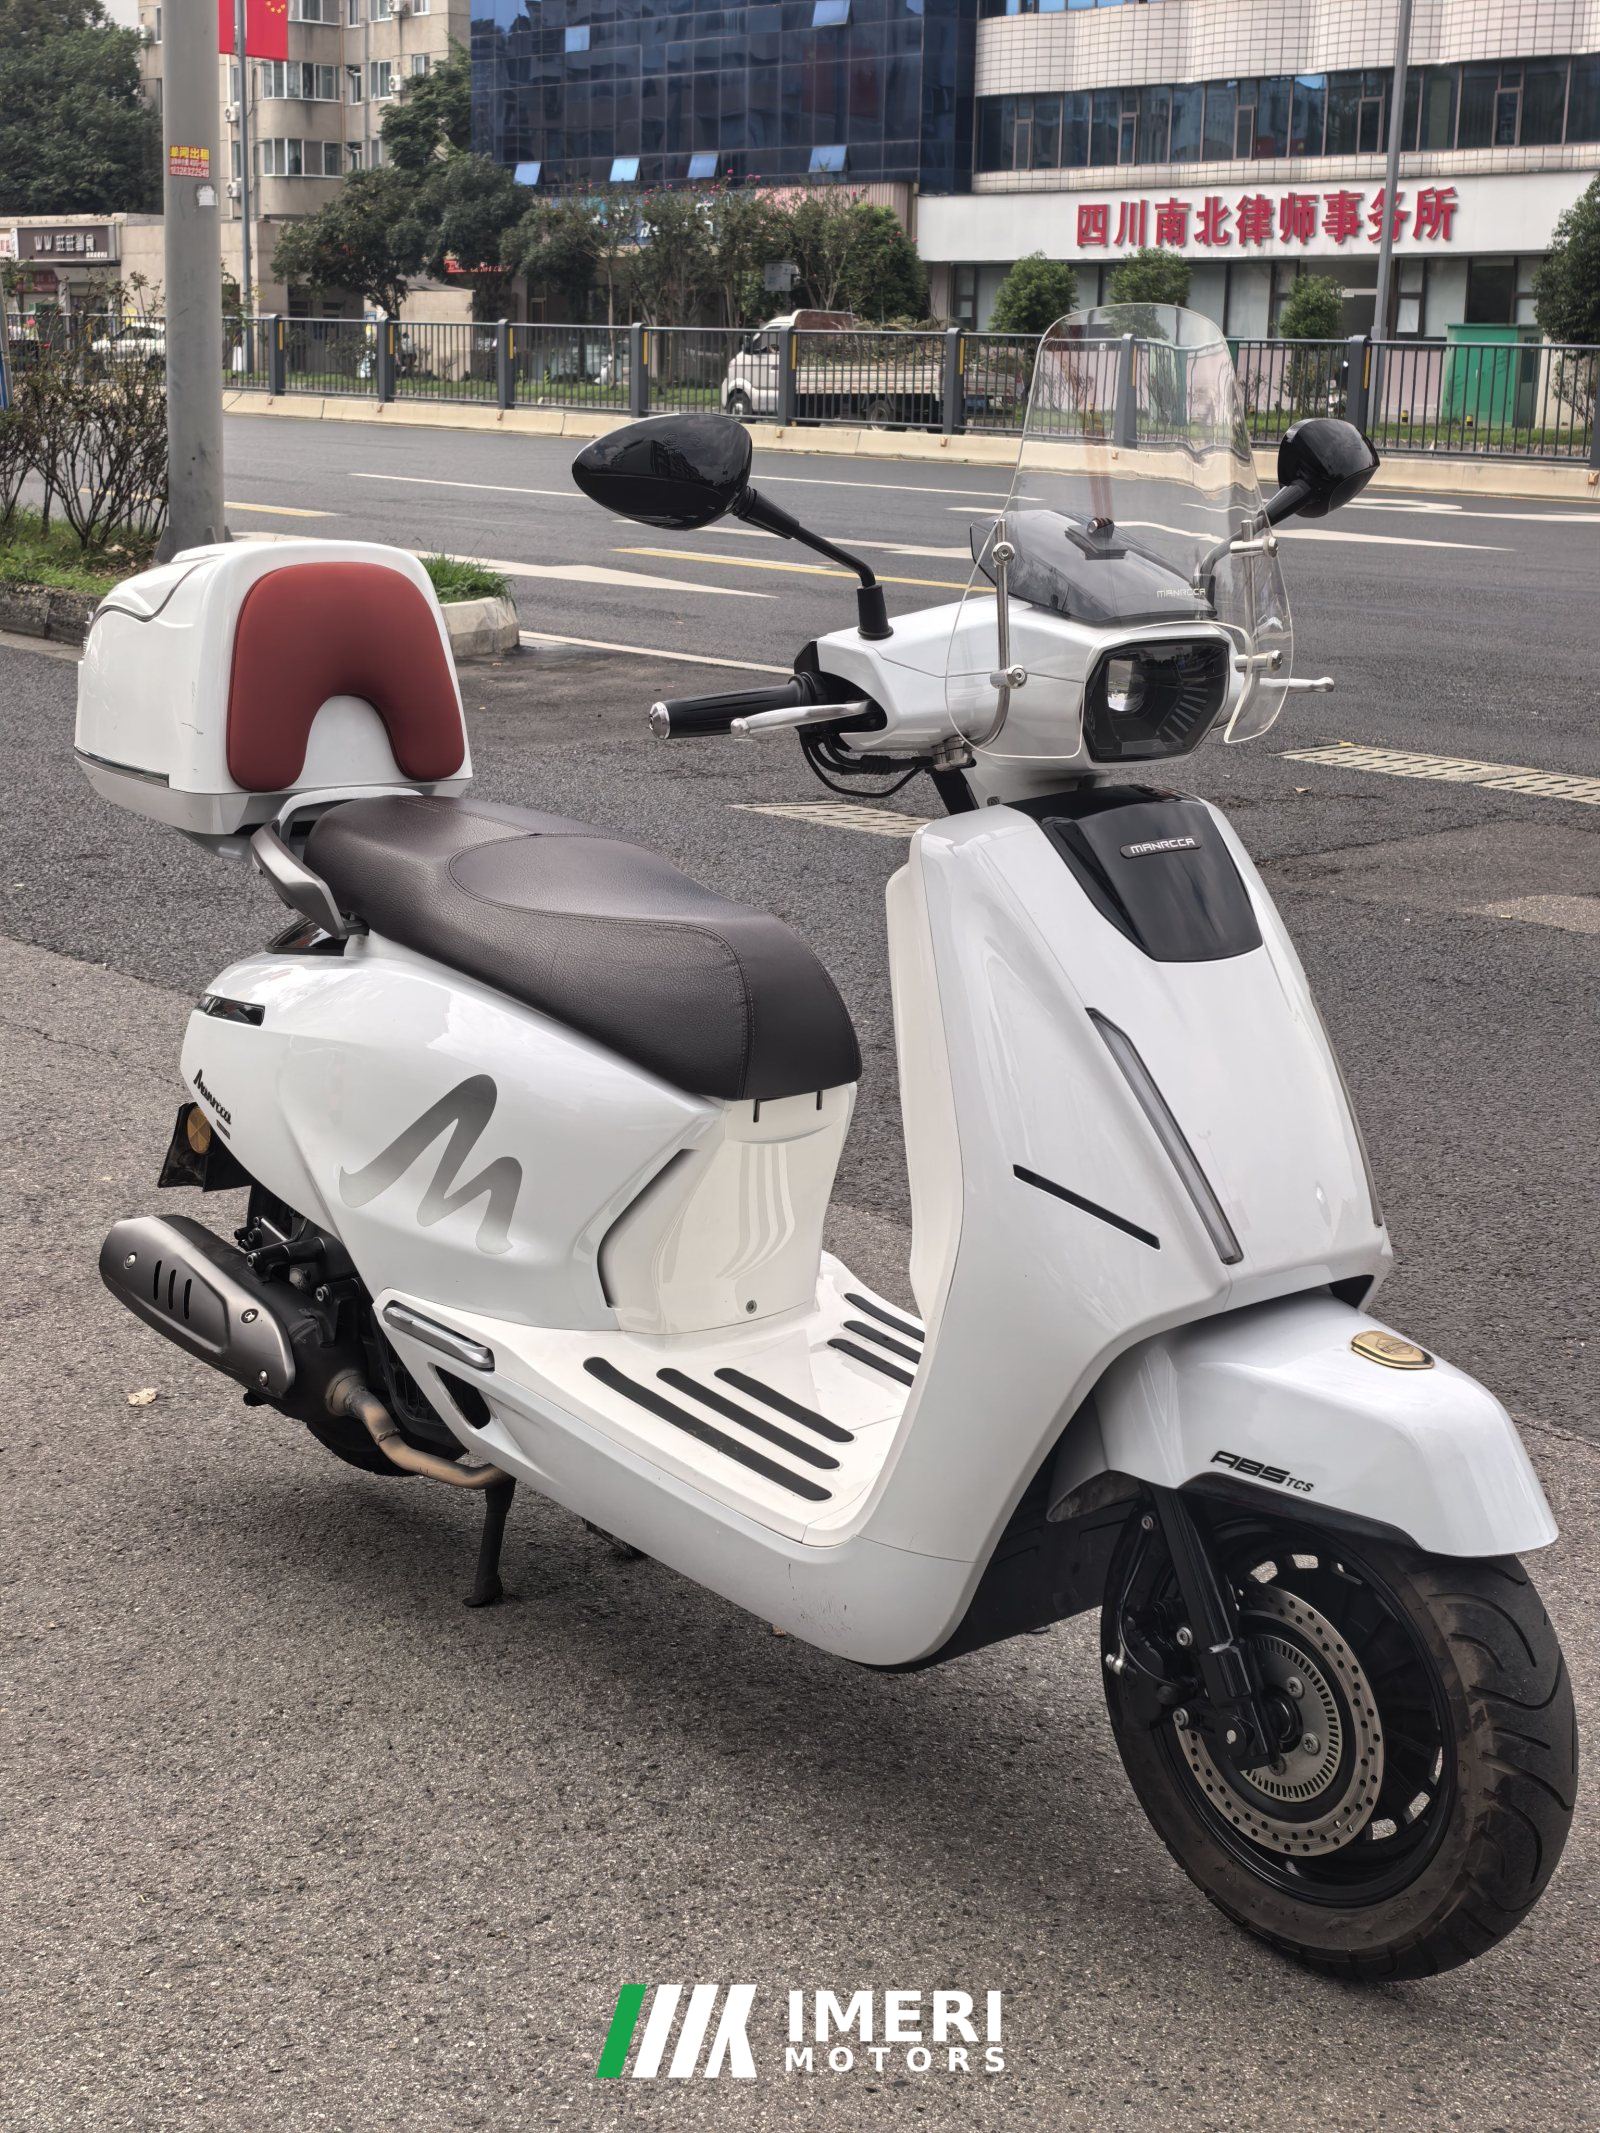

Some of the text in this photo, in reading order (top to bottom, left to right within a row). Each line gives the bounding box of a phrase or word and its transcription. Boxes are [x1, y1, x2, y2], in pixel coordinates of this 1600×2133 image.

[1076, 186, 1459, 247] 四川南北律师事务所
[1210, 1450, 1315, 1493] ABS TCS
